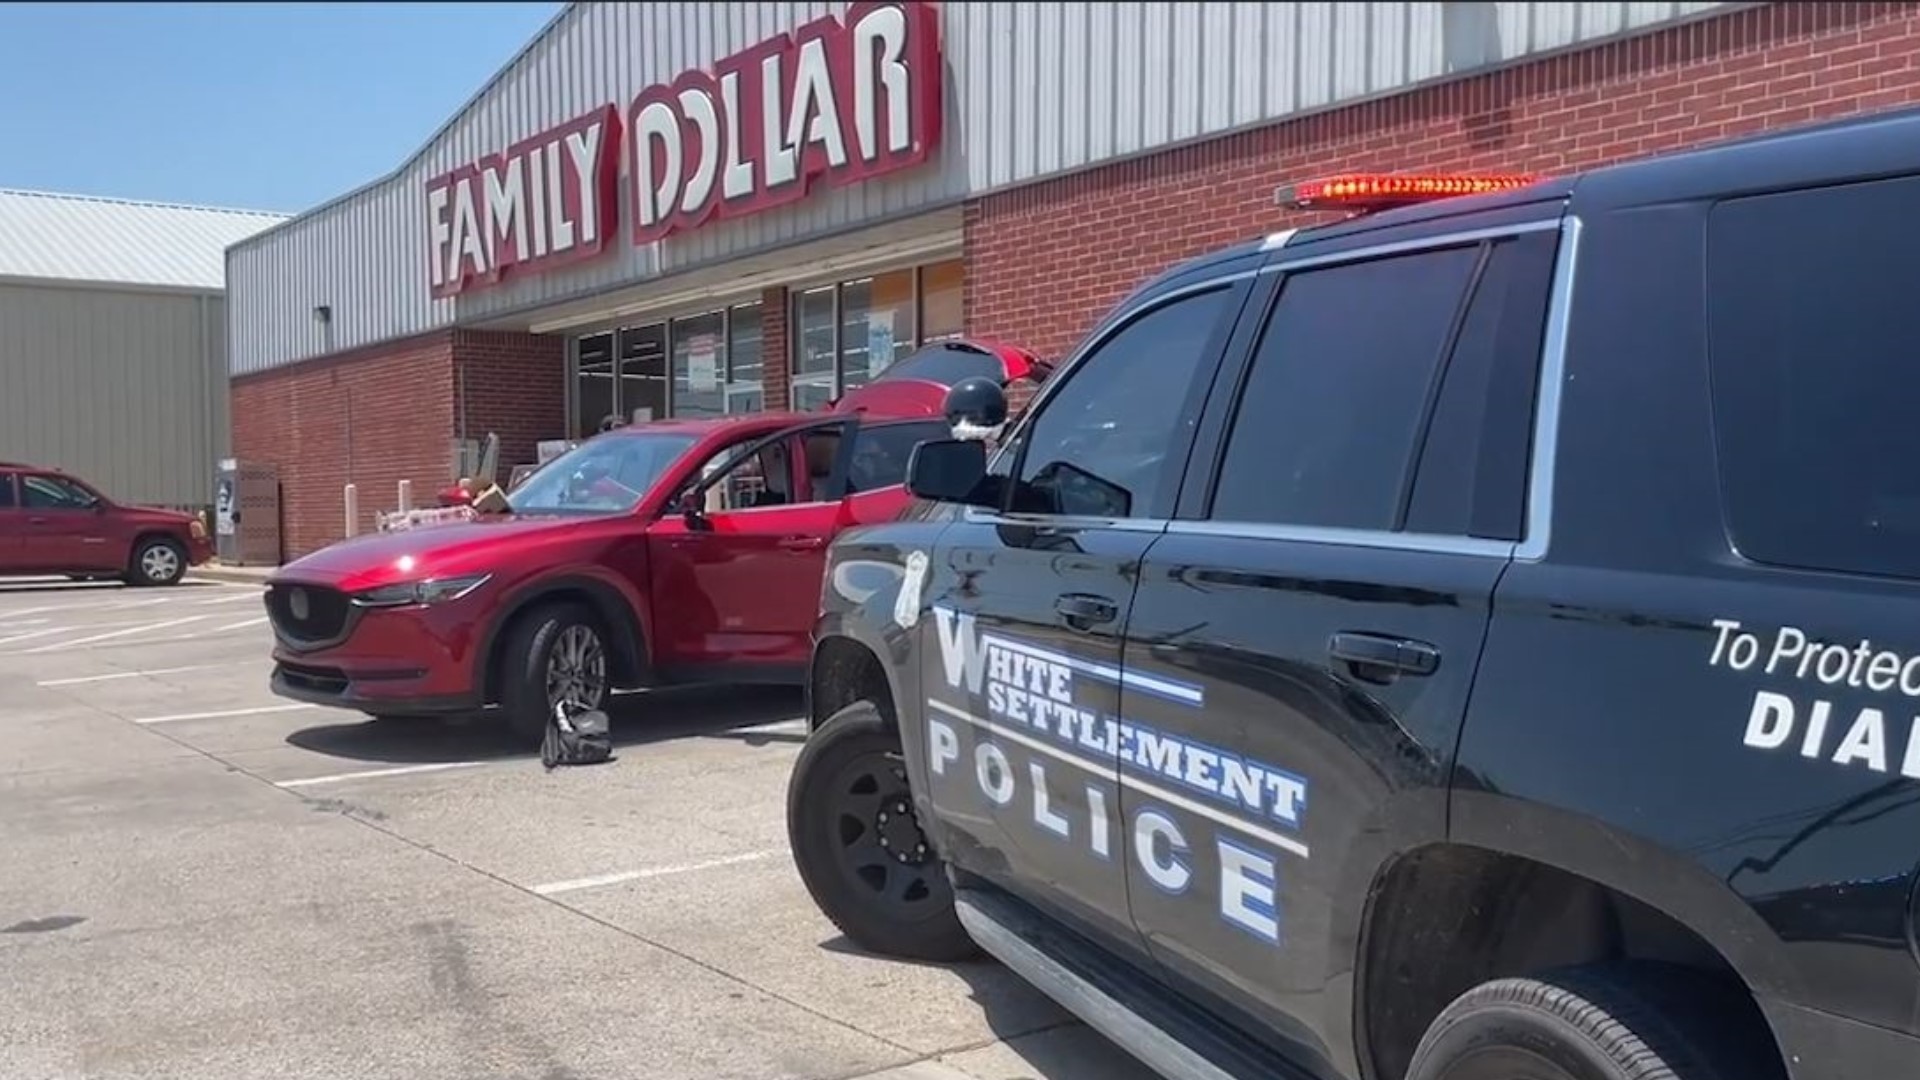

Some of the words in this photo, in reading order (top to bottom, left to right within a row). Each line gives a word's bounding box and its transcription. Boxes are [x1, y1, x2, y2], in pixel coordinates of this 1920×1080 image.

[428, 121, 602, 287] FAMILY
[633, 4, 910, 227] DOLLAR
[932, 606, 1072, 705] WHITE
[1709, 618, 1759, 670] To
[1764, 625, 1920, 697] Protec
[987, 682, 1307, 824] SETTLEMENT
[928, 719, 1280, 942] POLICE
